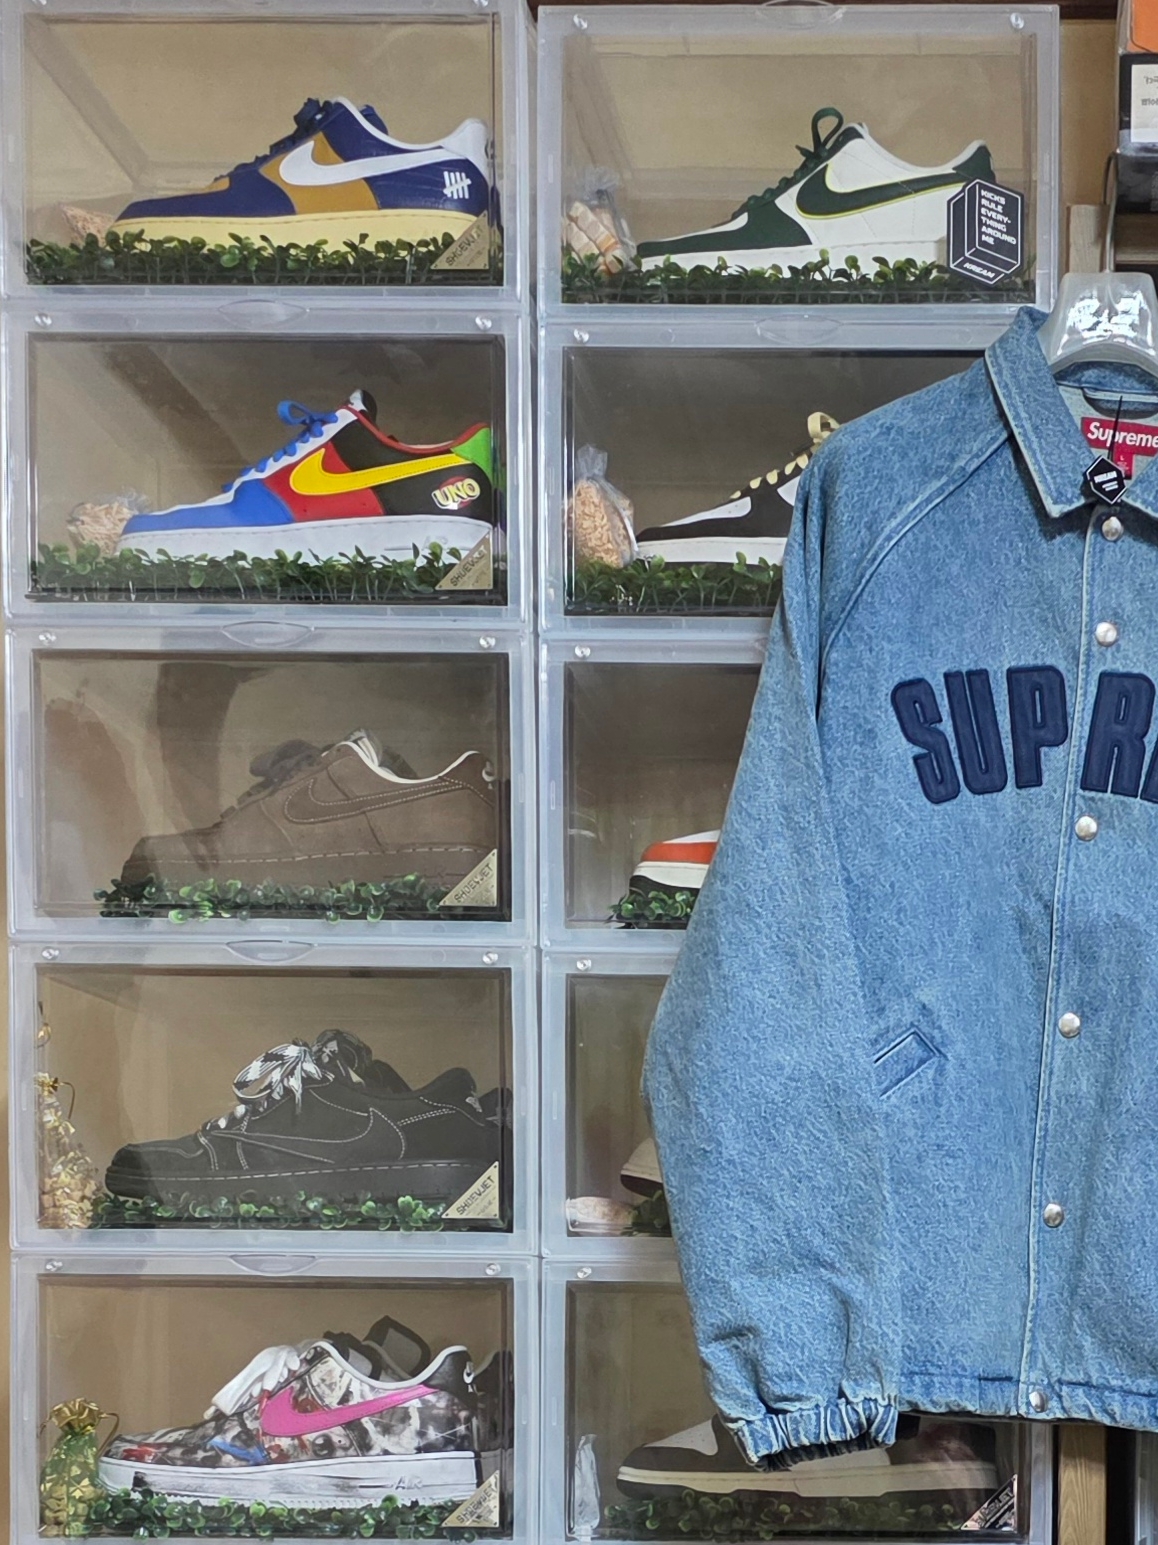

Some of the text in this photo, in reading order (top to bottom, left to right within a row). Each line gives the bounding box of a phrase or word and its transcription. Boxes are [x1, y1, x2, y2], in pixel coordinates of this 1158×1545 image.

[981, 189, 1005, 205] KICKS
[981, 198, 1003, 213] RULE
[981, 207, 1011, 223] EVERY-
[981, 216, 1007, 232] THING
[981, 226, 1017, 245] AROUND
[981, 235, 994, 245] ME
[963, 262, 995, 278] KREAM
[431, 478, 481, 510] UNO
